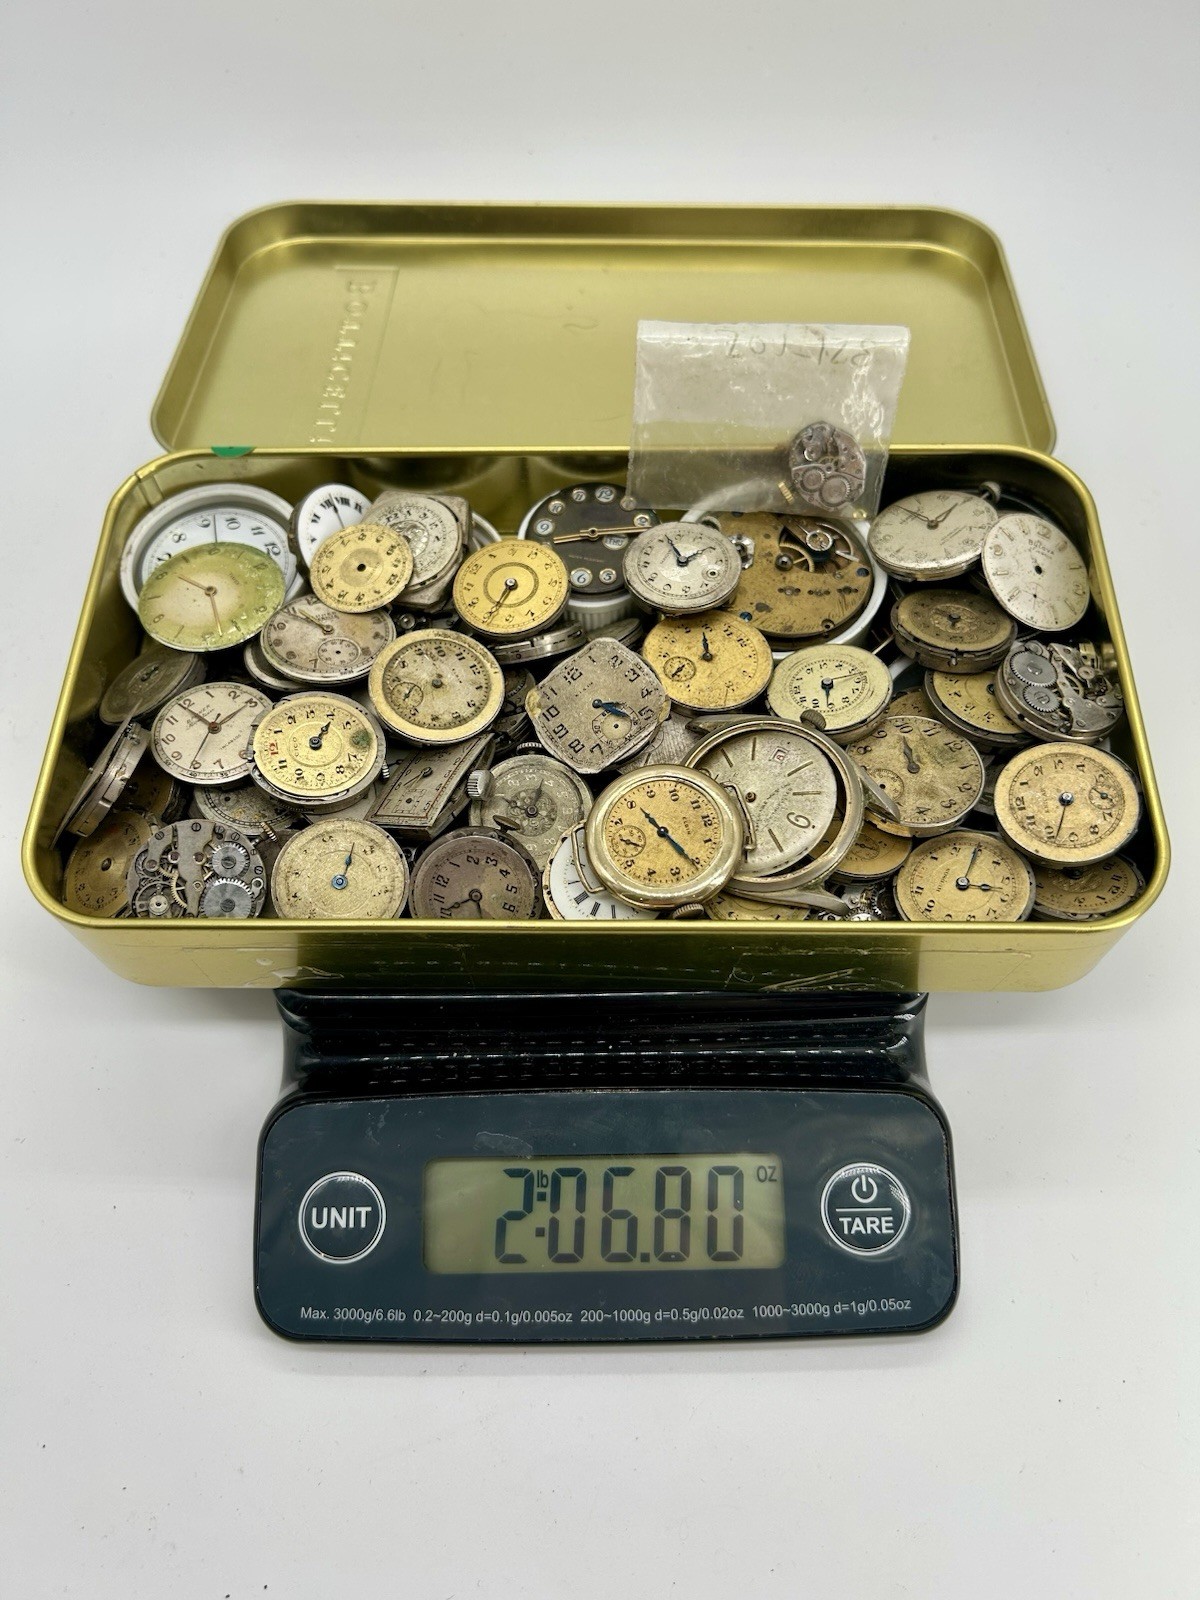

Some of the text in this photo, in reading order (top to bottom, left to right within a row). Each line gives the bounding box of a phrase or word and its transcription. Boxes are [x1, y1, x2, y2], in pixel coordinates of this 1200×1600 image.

[536, 1169, 549, 1188] lb
[312, 1206, 372, 1229] UNIT
[838, 1216, 895, 1235] TARE
[300, 1298, 912, 1325] Max. 3000g/6.6lb 0.2~200g d=0.1g/0.005oz 200~1000g d=0.5g/0.02oz 1000~3000g d=1g/0.05oz
